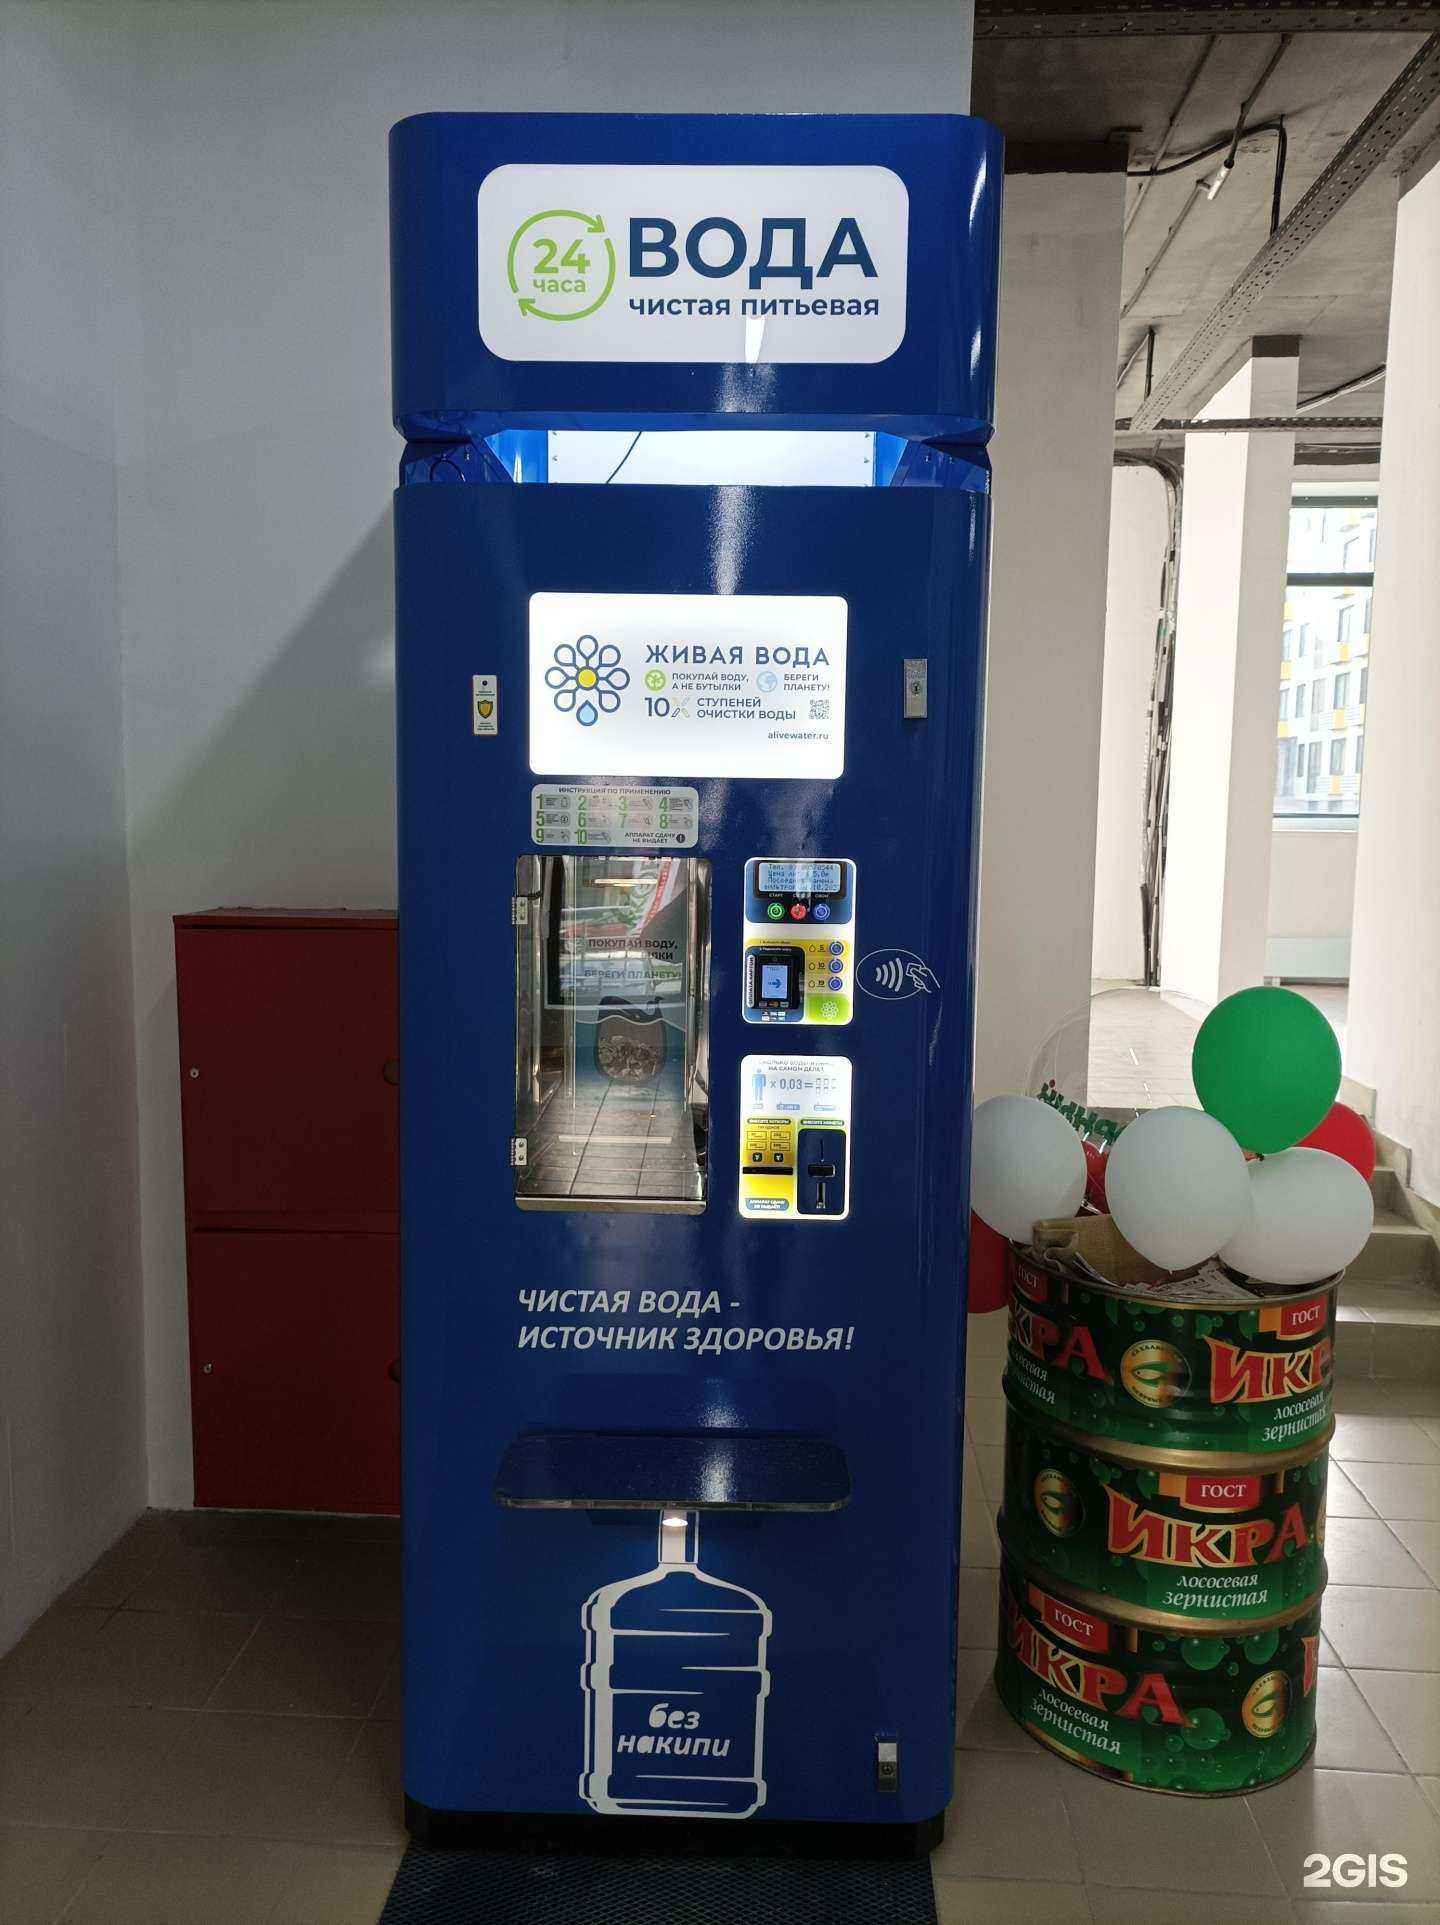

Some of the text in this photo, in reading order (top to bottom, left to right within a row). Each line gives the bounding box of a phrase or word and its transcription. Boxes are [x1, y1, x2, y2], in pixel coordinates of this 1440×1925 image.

[532, 238, 591, 274] 24
[629, 217, 878, 290] ВОДА
[532, 277, 586, 293] часа
[629, 297, 879, 315] чистая питьевая
[645, 645, 830, 668] ЖИВАЯ ВОДА
[672, 671, 749, 683] ПОКУПАЙ ВОДУ,
[784, 673, 819, 682] БЕРЕГИ
[672, 683, 741, 691] А НЕ БУТЫЛКИ
[784, 683, 830, 692] ПЛАНЕТУ!
[644, 696, 670, 717] 10
[697, 696, 761, 708] СТУПЕНЕЙ
[696, 709, 796, 721] ОЧИСТКИ ВОДЫ
[767, 730, 829, 741] alivewater.ru
[536, 794, 543, 809] 1
[578, 795, 587, 810] 2
[660, 797, 668, 812] 4
[536, 811, 544, 826] 5
[578, 812, 586, 827] 6
[660, 814, 668, 829] 8
[536, 828, 544, 843] 9
[575, 829, 587, 844] 10
[588, 939, 678, 949] ПОКУПАЙ ВОДУ,
[584, 970, 625, 978] БЕРЕГИ
[780, 1079, 803, 1090] 0,03
[518, 1289, 631, 1313] ЧИСТАЯ
[638, 1290, 721, 1318] ВОДА
[1291, 1305, 1321, 1326] ГОСТ
[518, 1326, 855, 1355] ИСТОЧНИК ЗДОРОВЬЯ!
[1200, 1484, 1247, 1499] ГОСТ
[1103, 1483, 1310, 1569] ИКРА
[1177, 1574, 1259, 1590] лососевая
[1162, 1588, 1268, 1611] зернистая
[1055, 1609, 1094, 1637] ГОСТ
[648, 1702, 701, 1730] без
[1038, 1688, 1110, 1732] лососевая
[1030, 1699, 1122, 1755] зернистая
[617, 1734, 731, 1757] накипи
